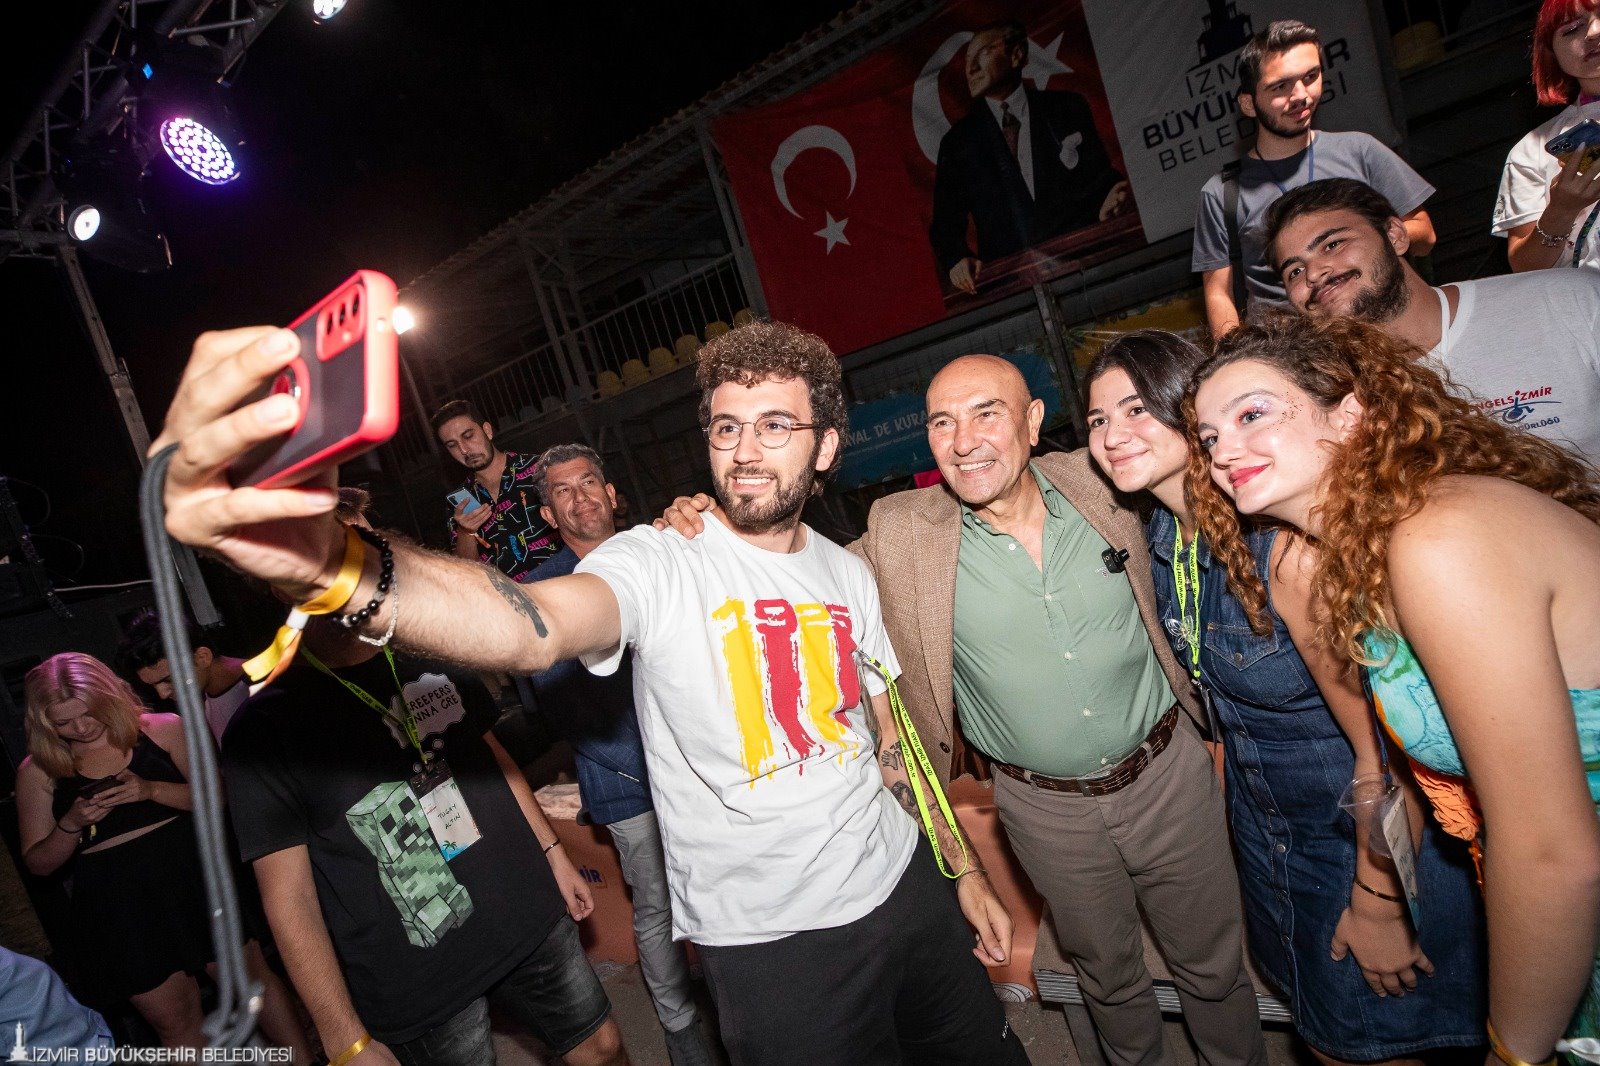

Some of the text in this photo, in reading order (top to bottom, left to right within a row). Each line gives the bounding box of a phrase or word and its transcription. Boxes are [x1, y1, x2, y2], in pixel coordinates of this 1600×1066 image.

[844, 429, 872, 448] AYAL
[873, 421, 892, 438] DE
[894, 410, 928, 432] KURA
[409, 684, 452, 711] REEPERS
